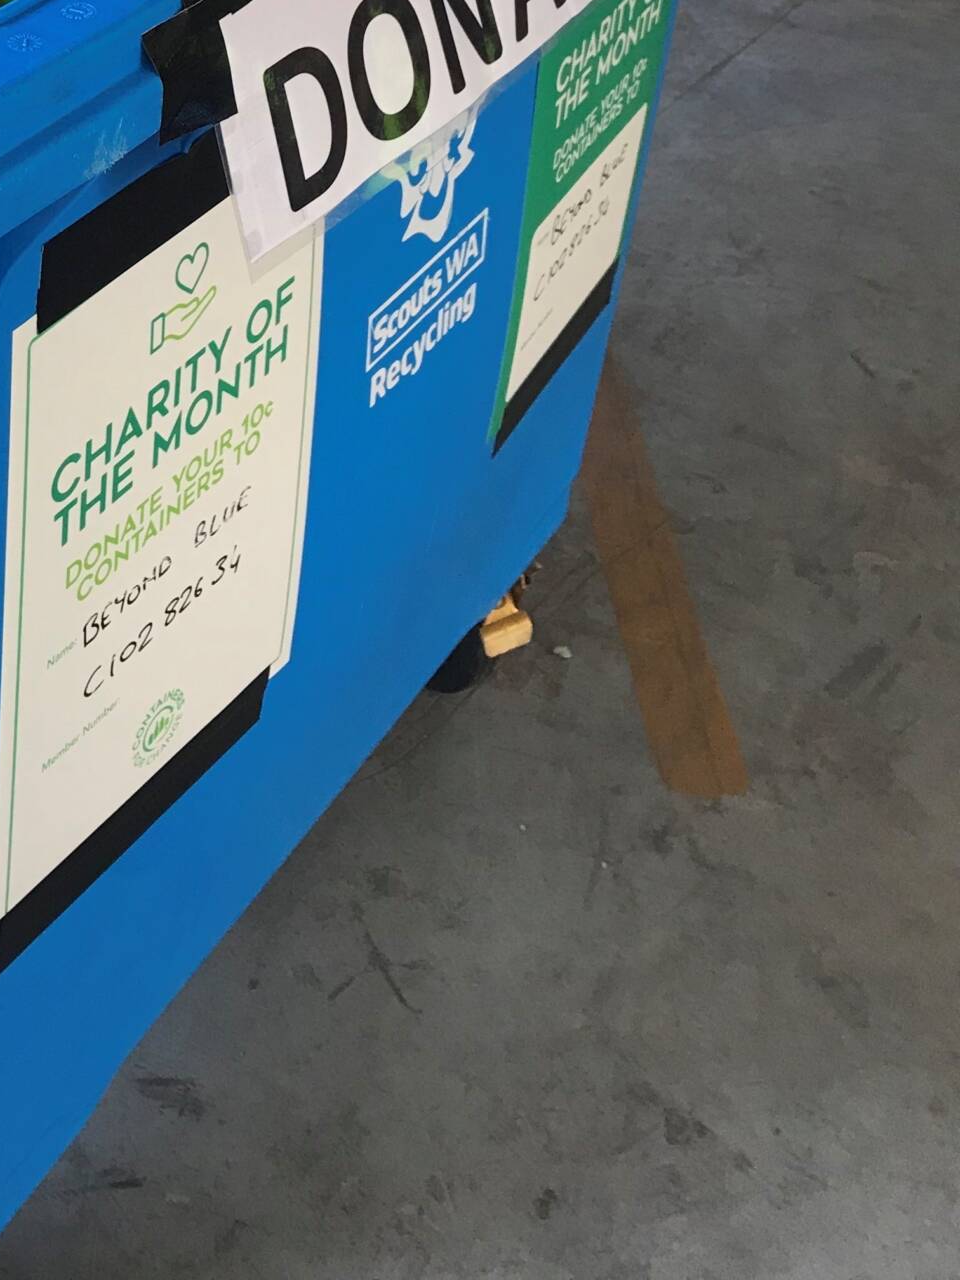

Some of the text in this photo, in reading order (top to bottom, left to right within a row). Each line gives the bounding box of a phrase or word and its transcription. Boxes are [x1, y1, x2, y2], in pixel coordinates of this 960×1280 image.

[553, 106, 598, 170] DONATE
[600, 73, 630, 114] YOUR
[555, 67, 593, 129] THE
[555, 79, 642, 183] CONTAINERS TO
[368, 282, 478, 409] Recycling
[372, 267, 443, 354] Scouts
[445, 232, 479, 284] WA
[50, 275, 296, 503] CHARITY OF
[53, 323, 289, 547] THE MONTH
[65, 486, 163, 589] DONATE
[171, 428, 233, 493] YOUR
[75, 430, 262, 602] CONTAINERS TO
[82, 485, 253, 648] BEYOND BLUE
